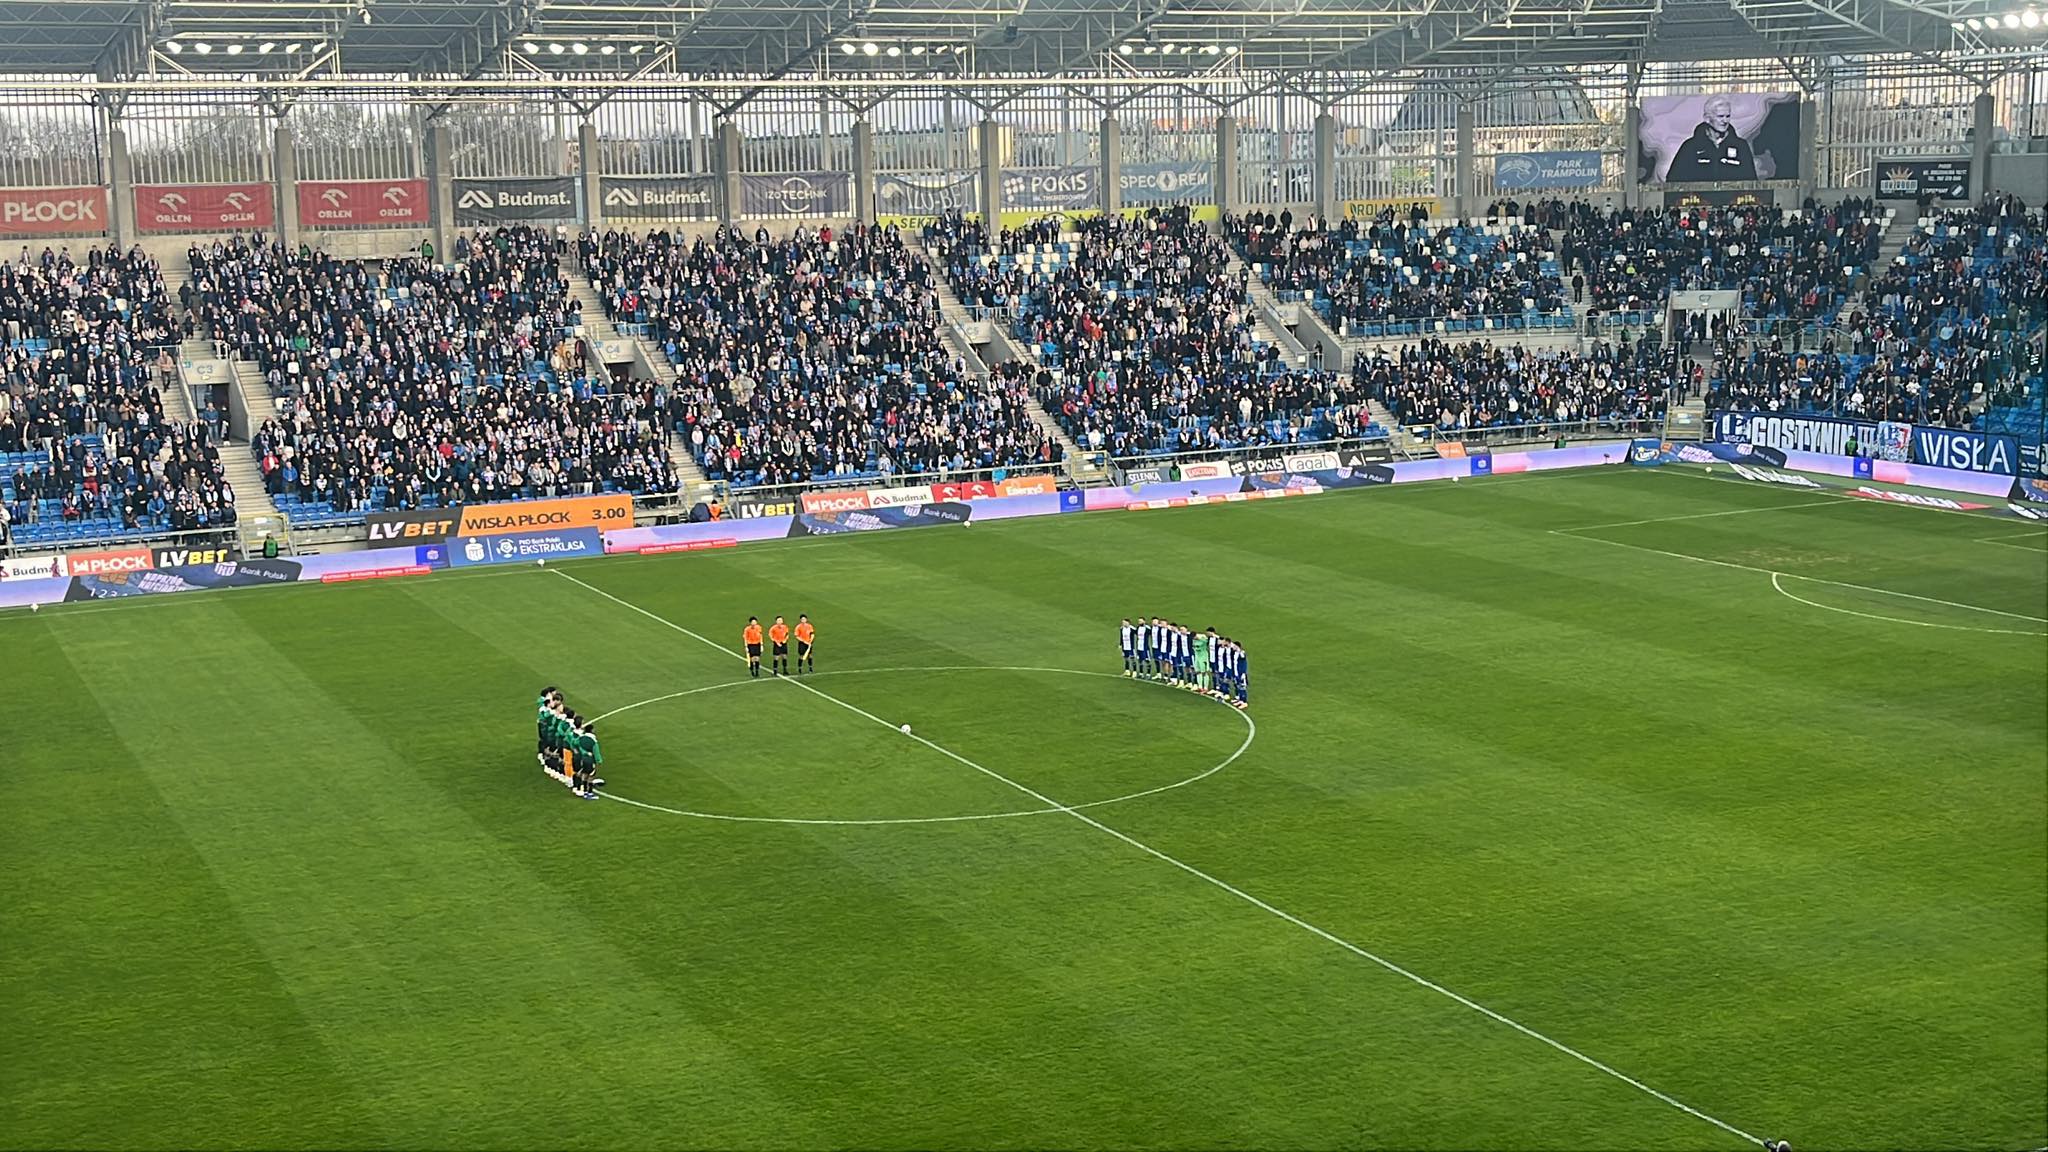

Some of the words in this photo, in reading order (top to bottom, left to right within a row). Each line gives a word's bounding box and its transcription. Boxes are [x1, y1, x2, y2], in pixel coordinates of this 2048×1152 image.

[1556, 159, 1583, 169] PARK
[1541, 168, 1598, 178] TRAMPOLIN
[1031, 173, 1088, 193] POKIS
[1120, 175, 1156, 189] SPEC
[1179, 172, 1208, 186] REM
[498, 191, 571, 207] Budmat.
[643, 190, 711, 205] Budmat.
[1682, 195, 1700, 206] pik
[1736, 194, 1756, 205] pik
[4, 199, 97, 223] PŁOCK
[220, 212, 255, 222] ORLEN
[318, 210, 352, 219] ORLEN
[379, 208, 413, 217] ORLEN
[155, 214, 192, 223] ORLEN
[900, 216, 945, 229] SEKT
[606, 344, 621, 354] C4
[197, 364, 213, 375] C3
[1921, 431, 2010, 474] WISŁA
[1247, 458, 1284, 472] POKIS
[822, 497, 865, 512] PŁOCK
[466, 515, 516, 530] WISŁA
[519, 511, 571, 527] PŁOCK
[592, 507, 626, 520] 3.00
[520, 540, 586, 555] EKSTRAKLASA
[90, 556, 148, 572] PŁOCK
[13, 566, 64, 576] Budm.
[240, 566, 261, 577] Bank
[263, 570, 288, 580] Polski
